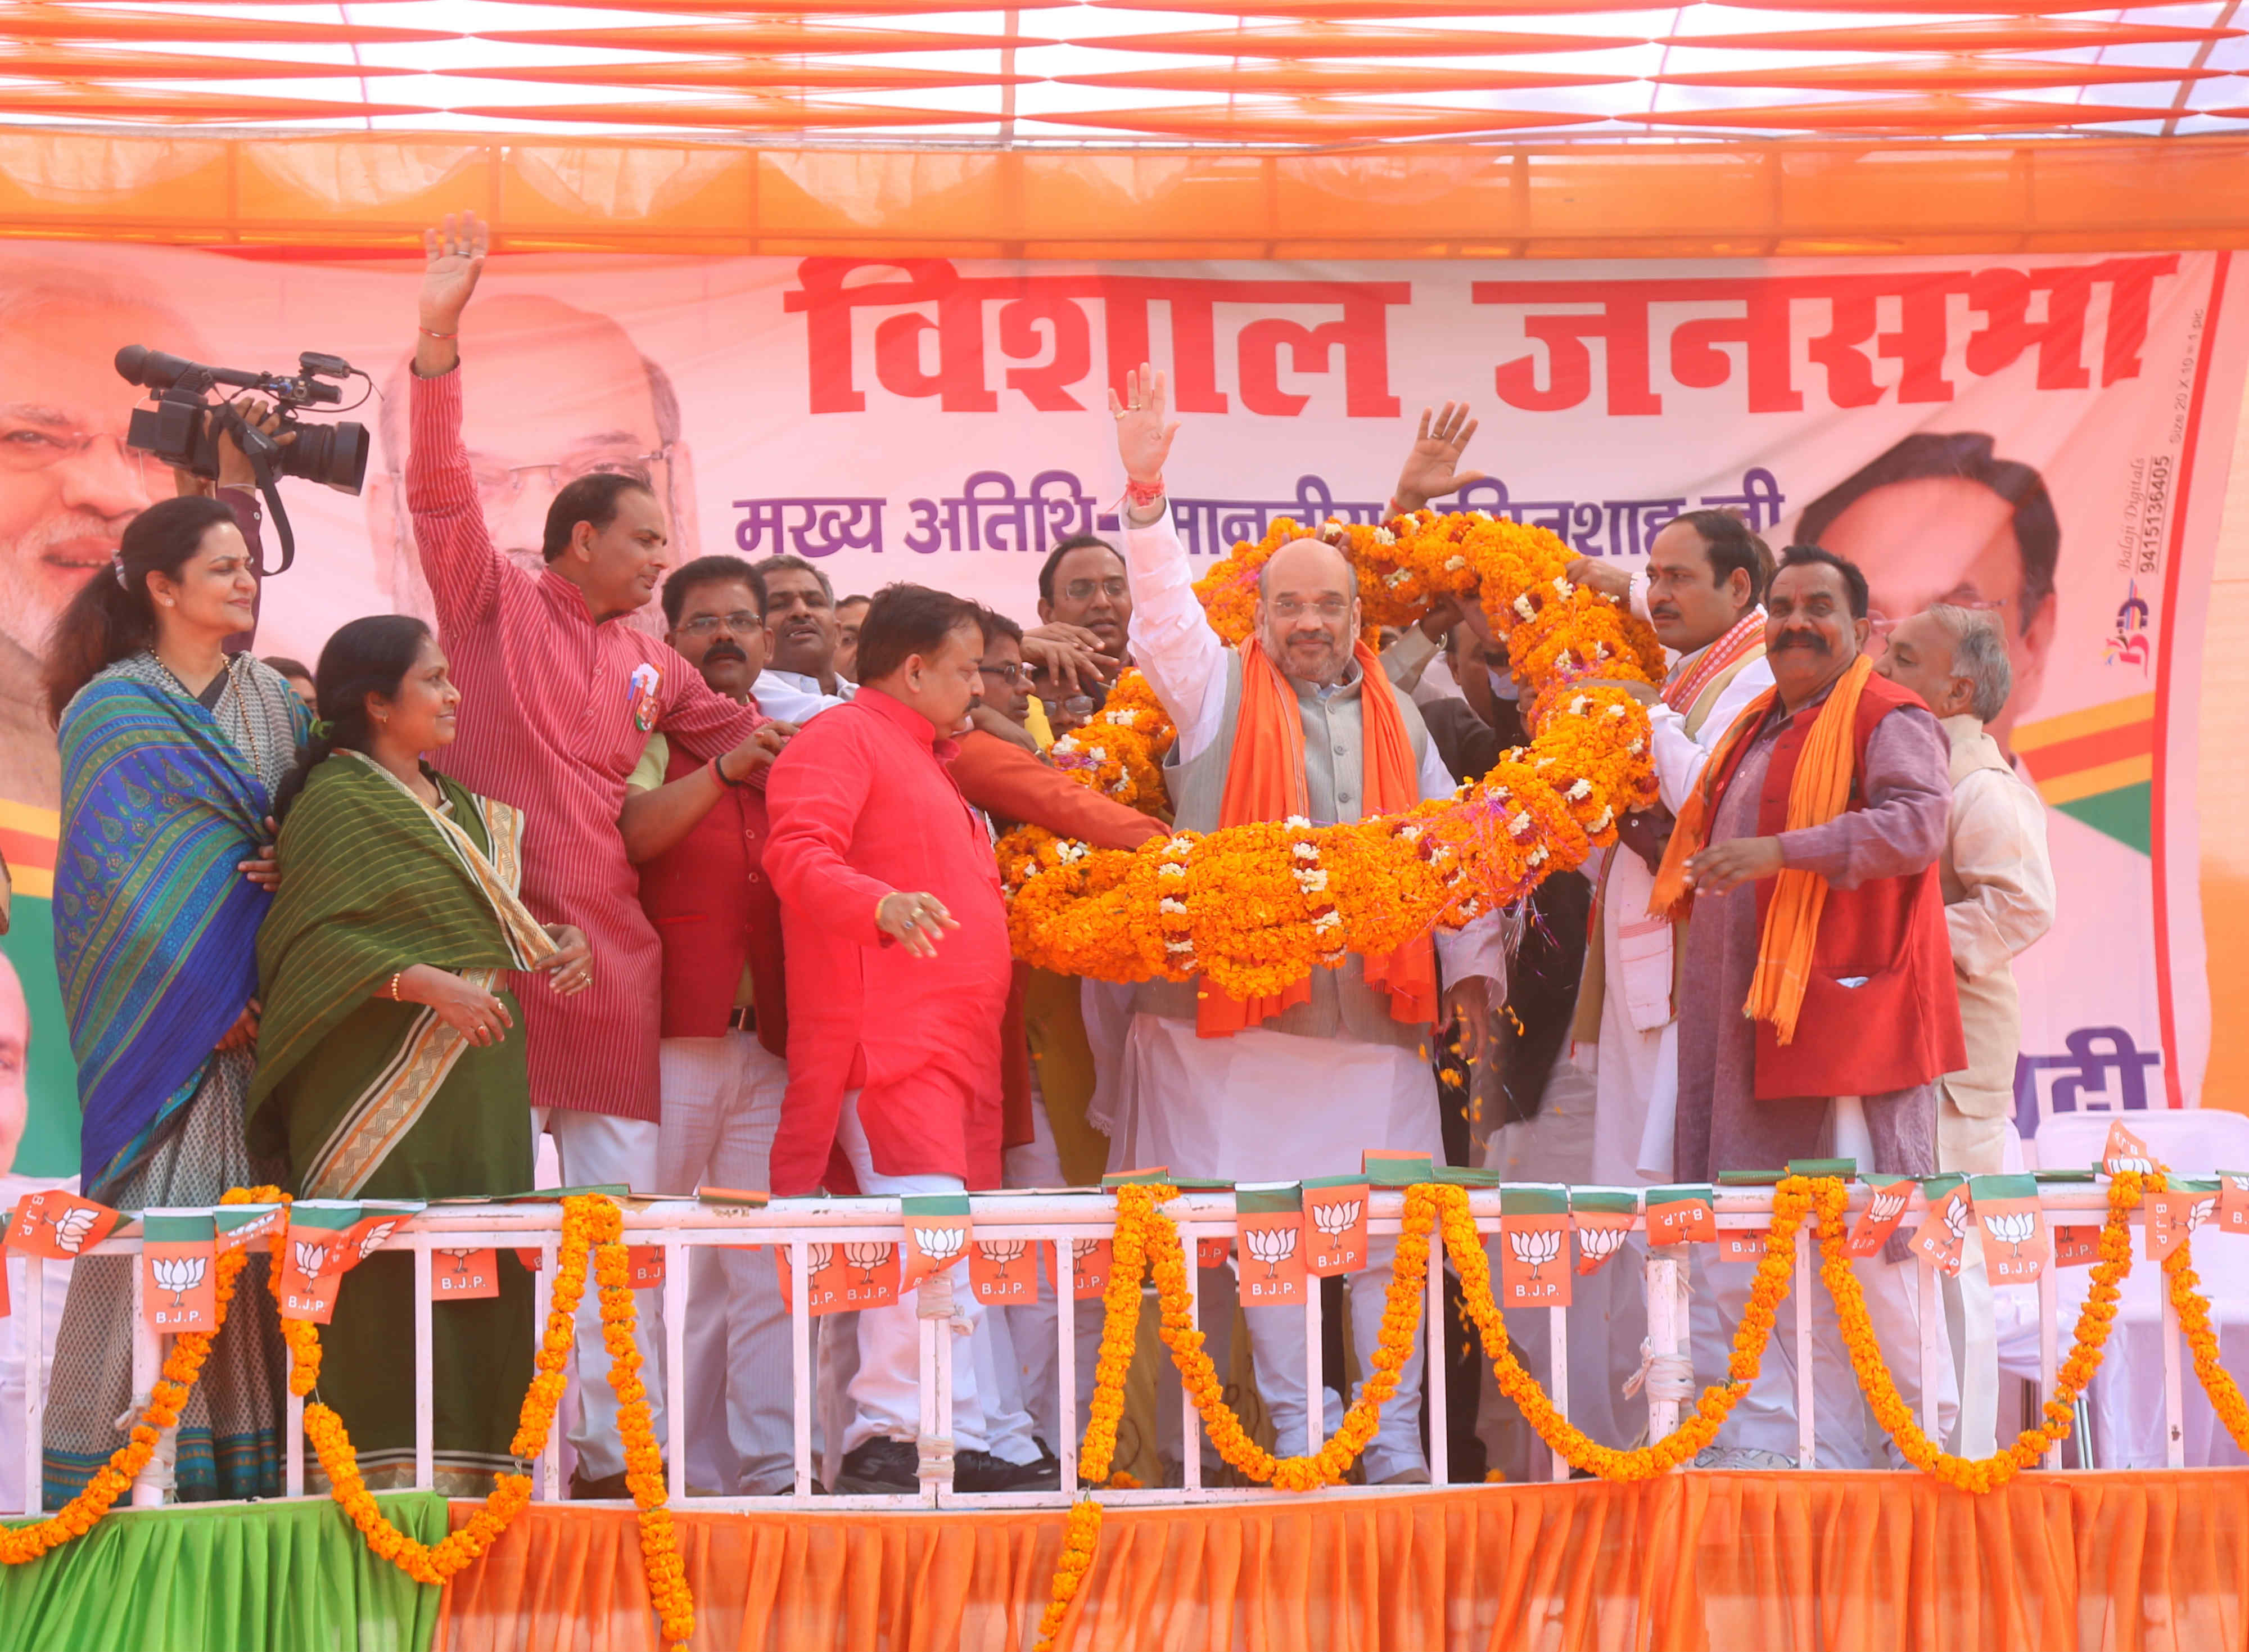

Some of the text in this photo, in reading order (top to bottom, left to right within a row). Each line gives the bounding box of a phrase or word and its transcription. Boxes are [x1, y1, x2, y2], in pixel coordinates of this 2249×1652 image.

[784, 253, 2181, 418] विशाल जनसभा
[2174, 392, 2188, 410] 20
[2118, 457, 2146, 572] Balaji Digitals
[2140, 455, 2170, 574] 9415136405
[733, 497, 887, 558] मख्य
[18, 1194, 44, 1237] B.J.P.
[1660, 1208, 1703, 1226] B.J.P.
[2155, 1203, 2168, 1249] B.J.P.
[1317, 1251, 1358, 1268] B.J.P.
[1998, 1261, 2043, 1275] B.J.P.
[441, 1275, 486, 1290] B.J.P.
[981, 1281, 1026, 1296] B.J.P.
[1252, 1281, 1296, 1296] B.J.P.
[1515, 1283, 1560, 1297] B.J.P.
[847, 1286, 891, 1301] B.J.P.
[288, 1295, 326, 1314] B.J.P.
[156, 1310, 202, 1324] B.J.P.
